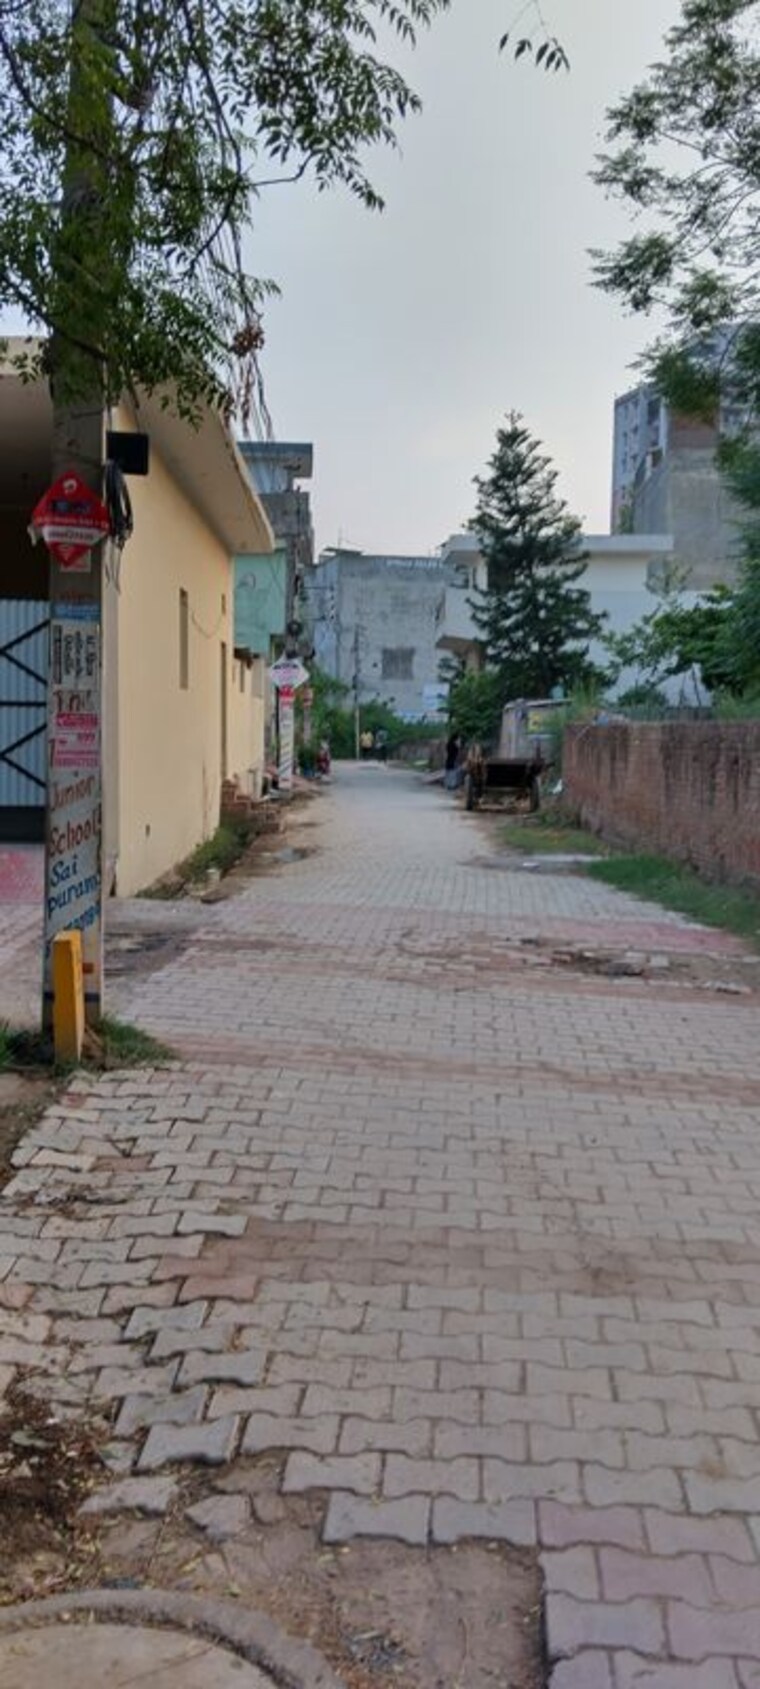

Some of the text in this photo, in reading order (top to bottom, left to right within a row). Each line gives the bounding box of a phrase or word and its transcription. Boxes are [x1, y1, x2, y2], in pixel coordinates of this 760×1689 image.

[51, 775, 96, 811] Junior
[48, 809, 97, 858] School
[51, 854, 77, 887] Sai
